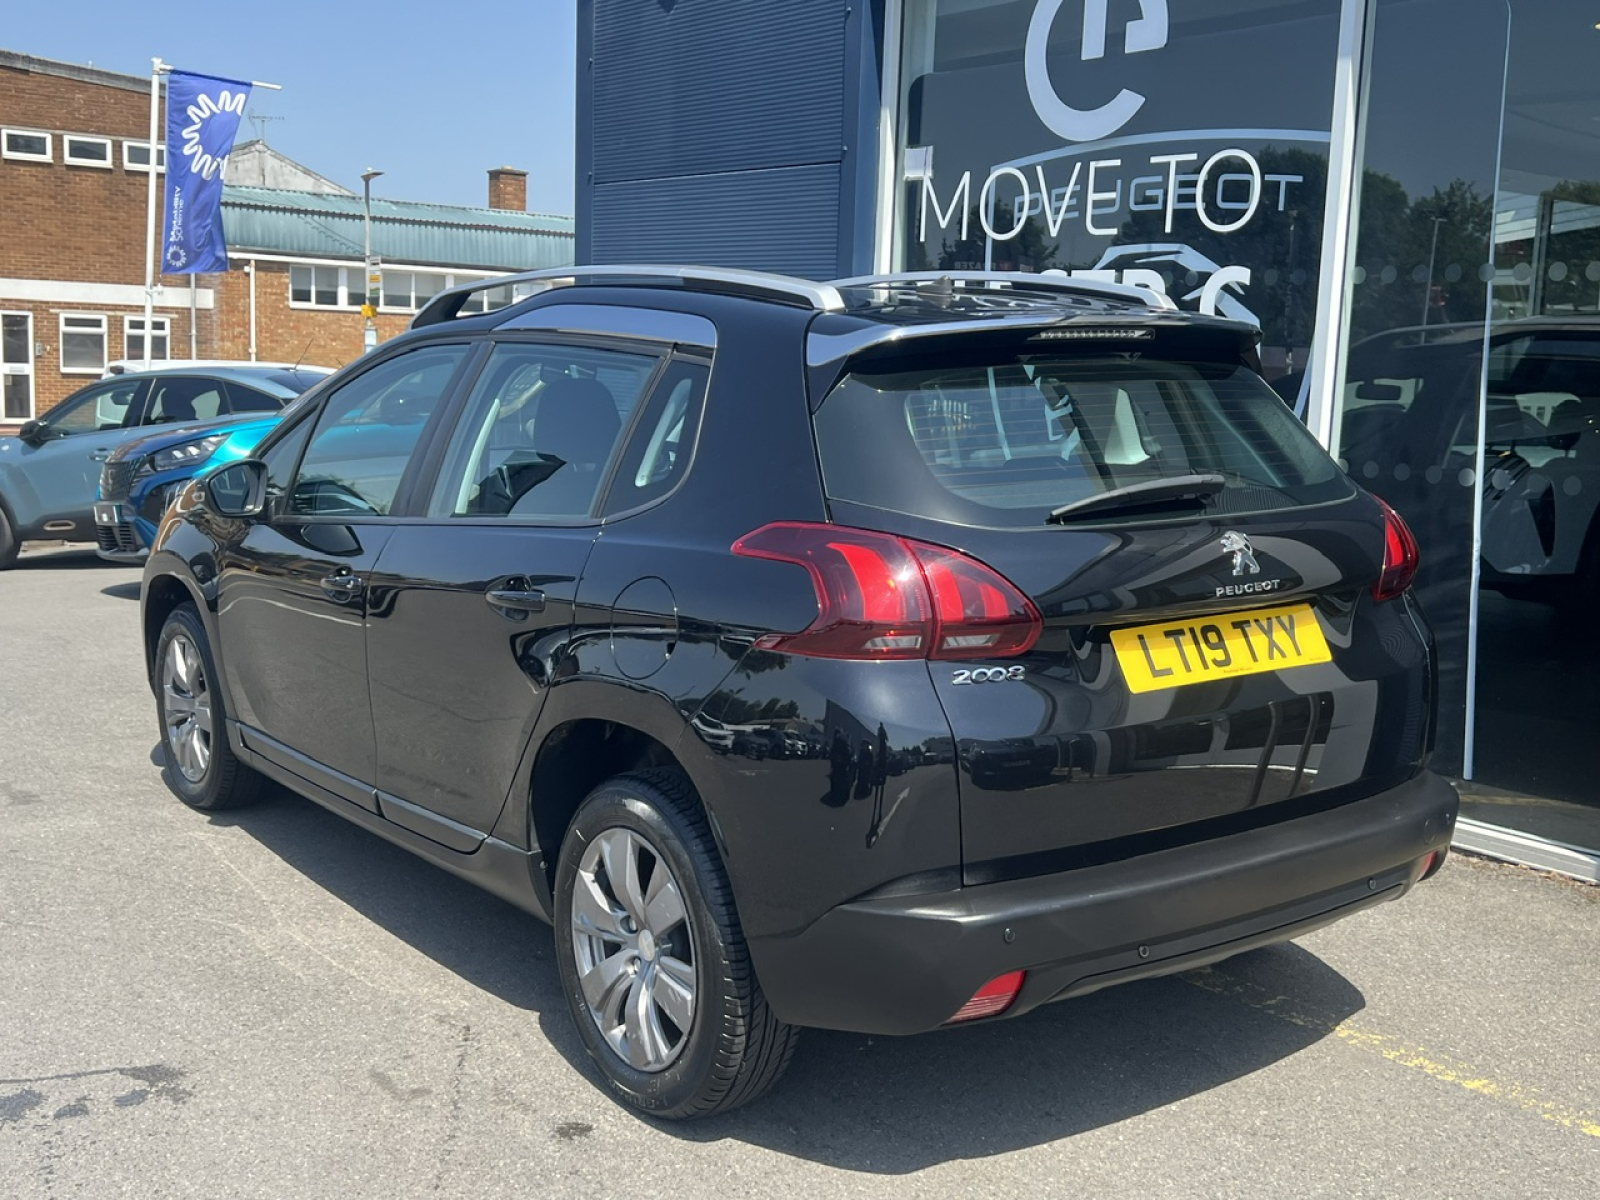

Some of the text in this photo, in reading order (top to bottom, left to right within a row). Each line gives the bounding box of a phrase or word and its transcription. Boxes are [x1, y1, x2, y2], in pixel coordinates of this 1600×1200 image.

[919, 148, 1261, 242] MOVE TO
[1013, 173, 1303, 229] PEUGEOT
[1216, 579, 1281, 597] PEUGEOT
[1137, 614, 1302, 678] LT19 TXY
[952, 665, 1026, 685] 2008
